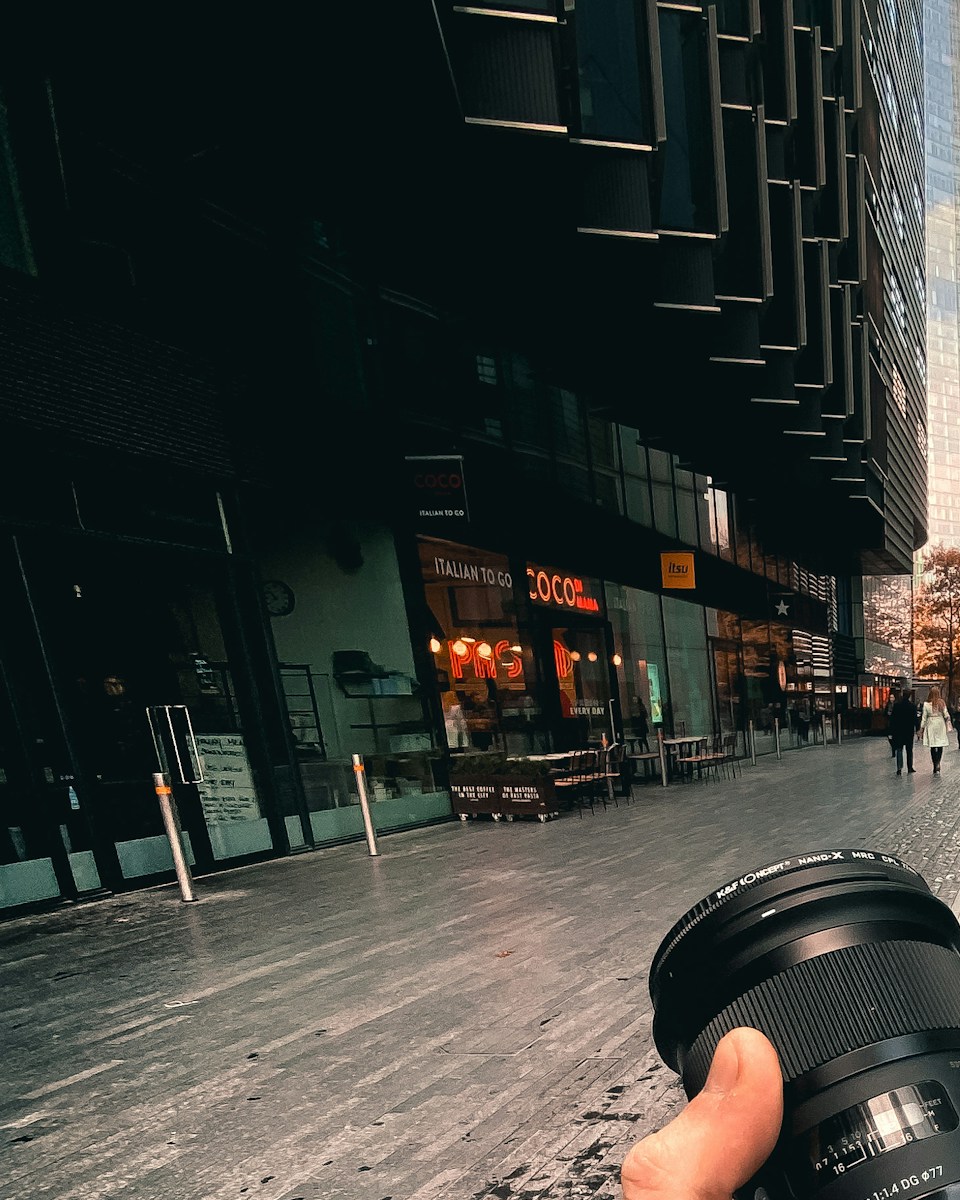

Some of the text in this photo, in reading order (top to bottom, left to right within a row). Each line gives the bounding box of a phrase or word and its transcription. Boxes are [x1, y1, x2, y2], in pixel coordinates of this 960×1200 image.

[414, 473, 462, 489] COCO
[418, 509, 465, 517] ITALIAN TO GO
[434, 556, 513, 588] ITALIAN TO GO
[569, 706, 605, 716] EVERY DAY
[716, 880, 739, 900] K&F
[851, 850, 876, 860] MRC
[832, 1162, 846, 1175] 16
[900, 1175, 920, 1191] DG
